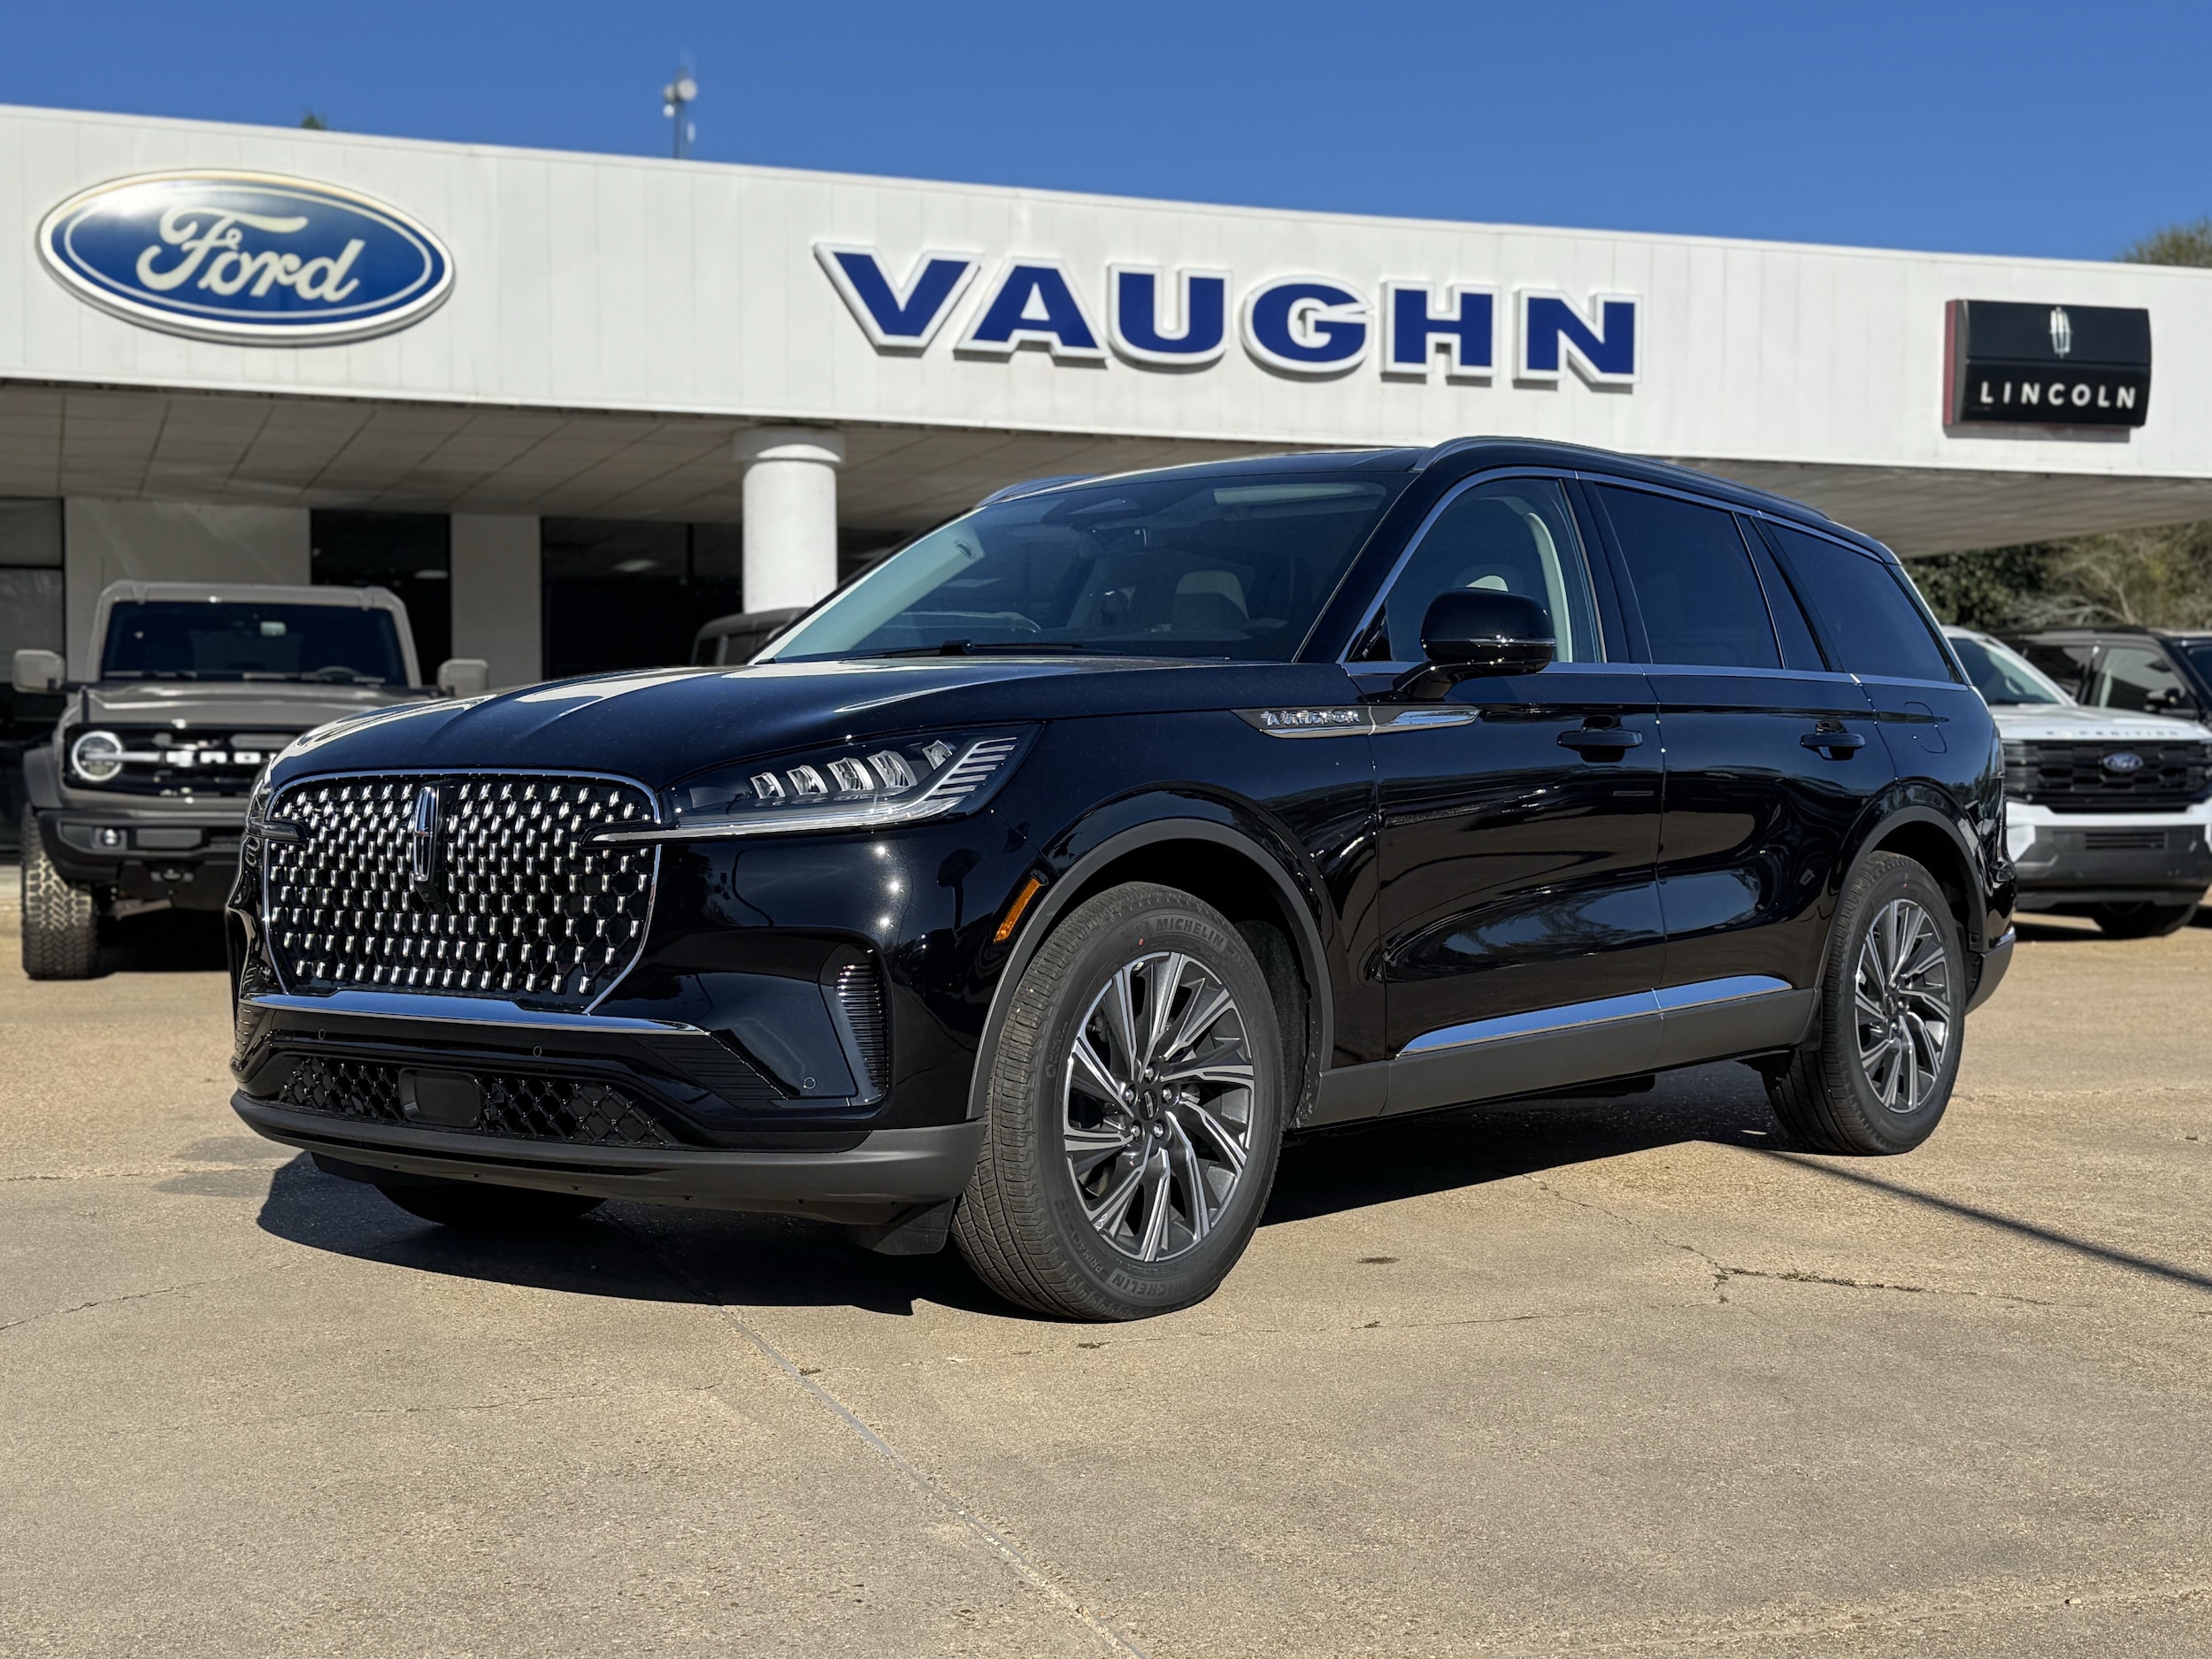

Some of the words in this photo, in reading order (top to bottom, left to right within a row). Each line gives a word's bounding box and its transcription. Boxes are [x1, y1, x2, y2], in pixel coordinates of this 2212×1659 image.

[136, 206, 365, 302] Ford
[815, 244, 1642, 384] VAUGHN
[1980, 380, 2136, 410] LINCOLN
[1156, 917, 1225, 947] MICHELIN
[1069, 1231, 1103, 1274] PRIMACY
